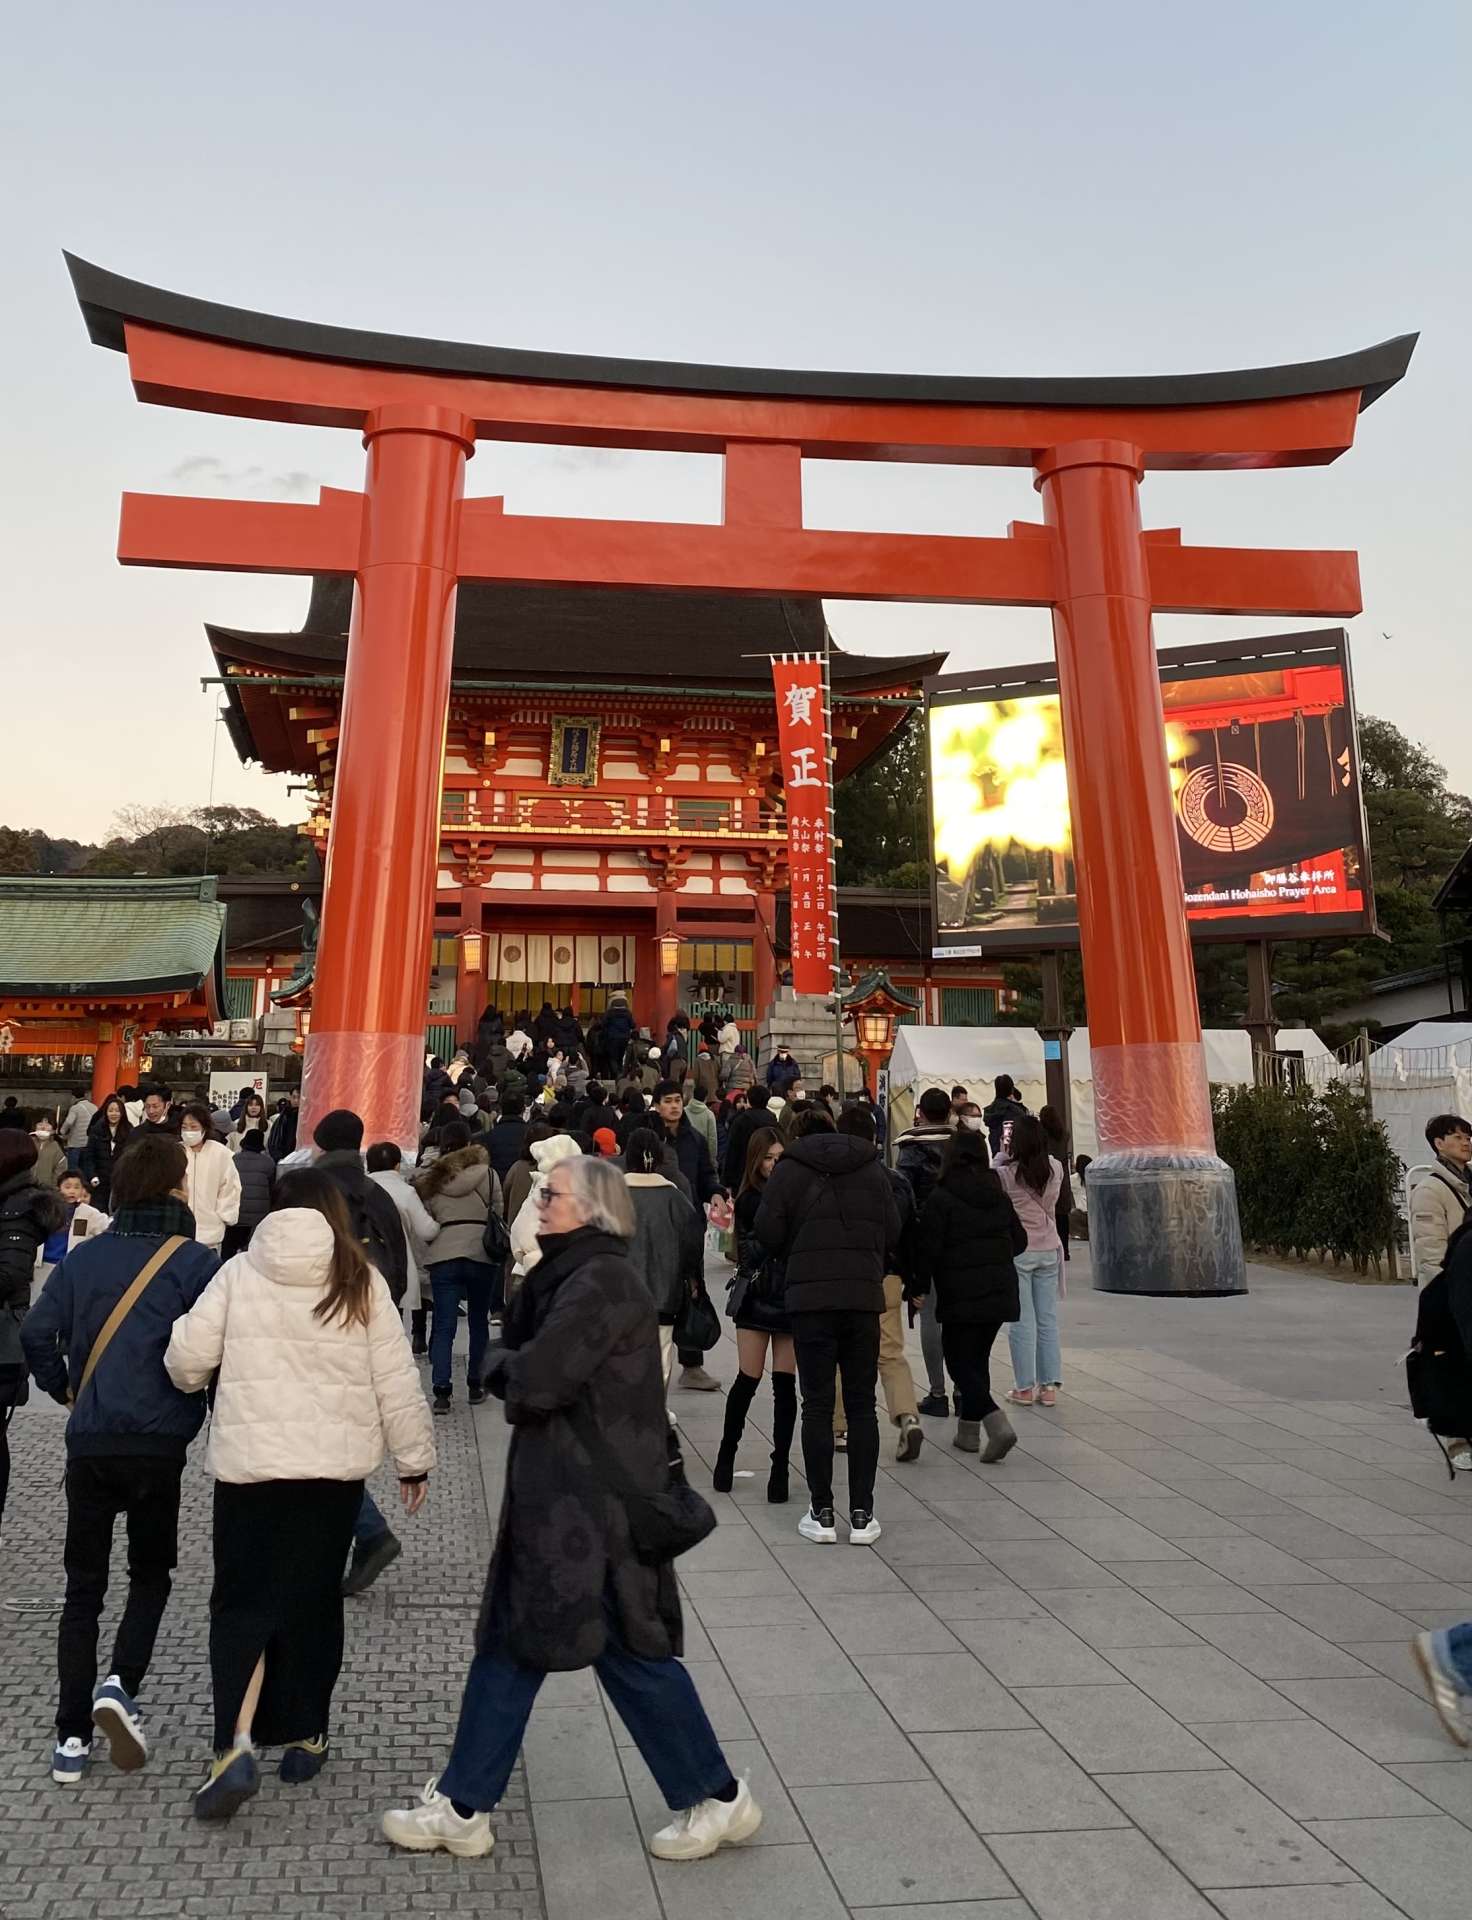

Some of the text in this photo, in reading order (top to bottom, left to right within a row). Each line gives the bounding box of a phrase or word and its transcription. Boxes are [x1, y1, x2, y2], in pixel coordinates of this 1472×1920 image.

[1231, 887, 1277, 900] Hohaisho
[1278, 886, 1311, 899] Prayer
[1312, 885, 1337, 895] Area
